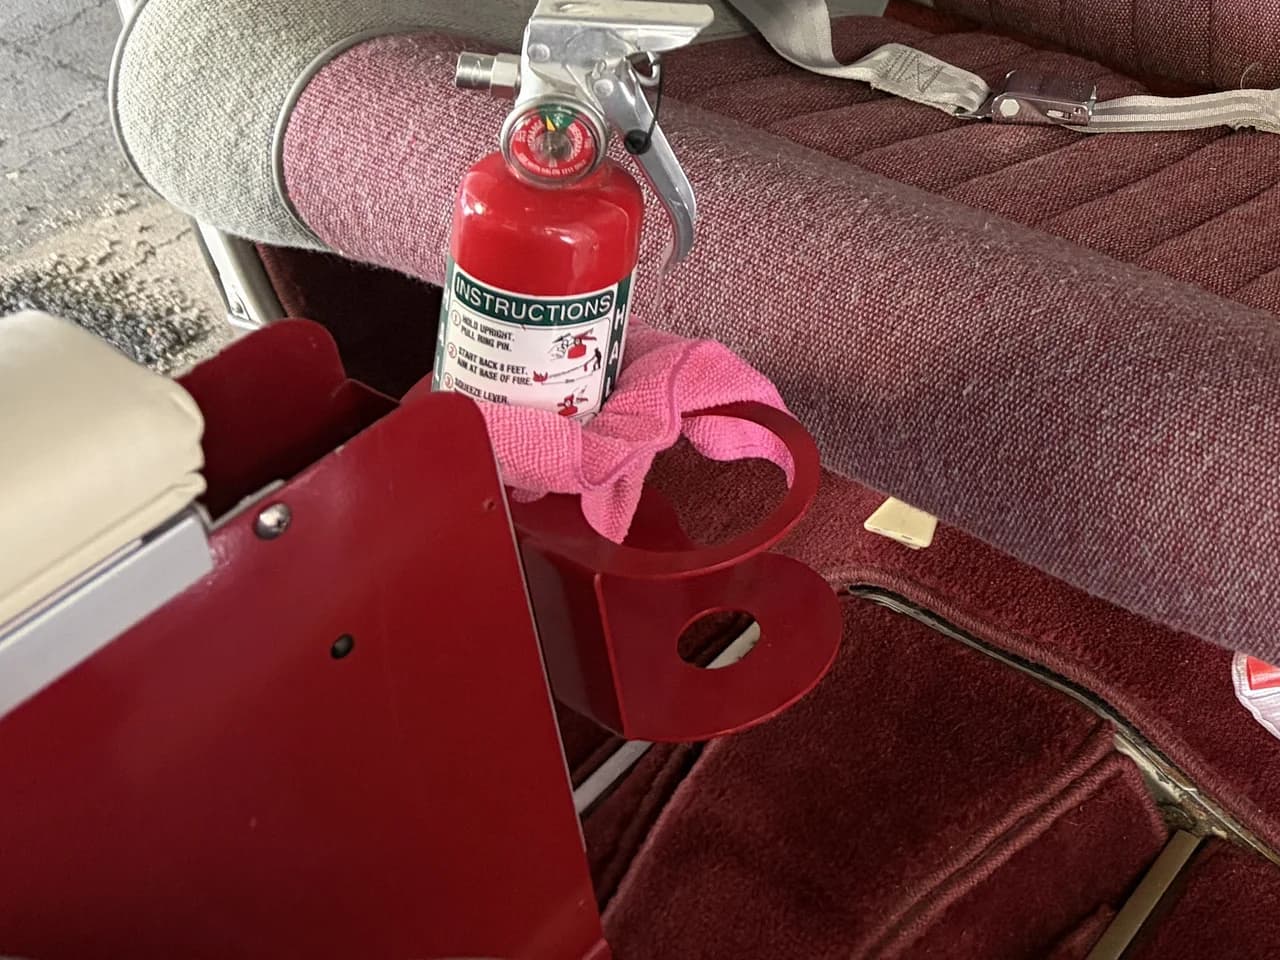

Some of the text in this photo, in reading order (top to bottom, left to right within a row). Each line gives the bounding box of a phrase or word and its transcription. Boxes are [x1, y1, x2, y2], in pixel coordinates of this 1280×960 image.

[456, 276, 611, 321] INSTRUCTIONS
[461, 325, 512, 352] PULL RING PIN.
[462, 315, 478, 330] HOLD
[479, 324, 515, 342] UPRIGHT.
[457, 356, 533, 386] AIM AT BASE OF FIRE.
[458, 346, 477, 362] START
[479, 356, 498, 371] BACK
[500, 363, 505, 372] 8
[506, 364, 528, 376] FEET.
[455, 377, 482, 398] SQUEEZE
[483, 390, 510, 405] LEVER.
